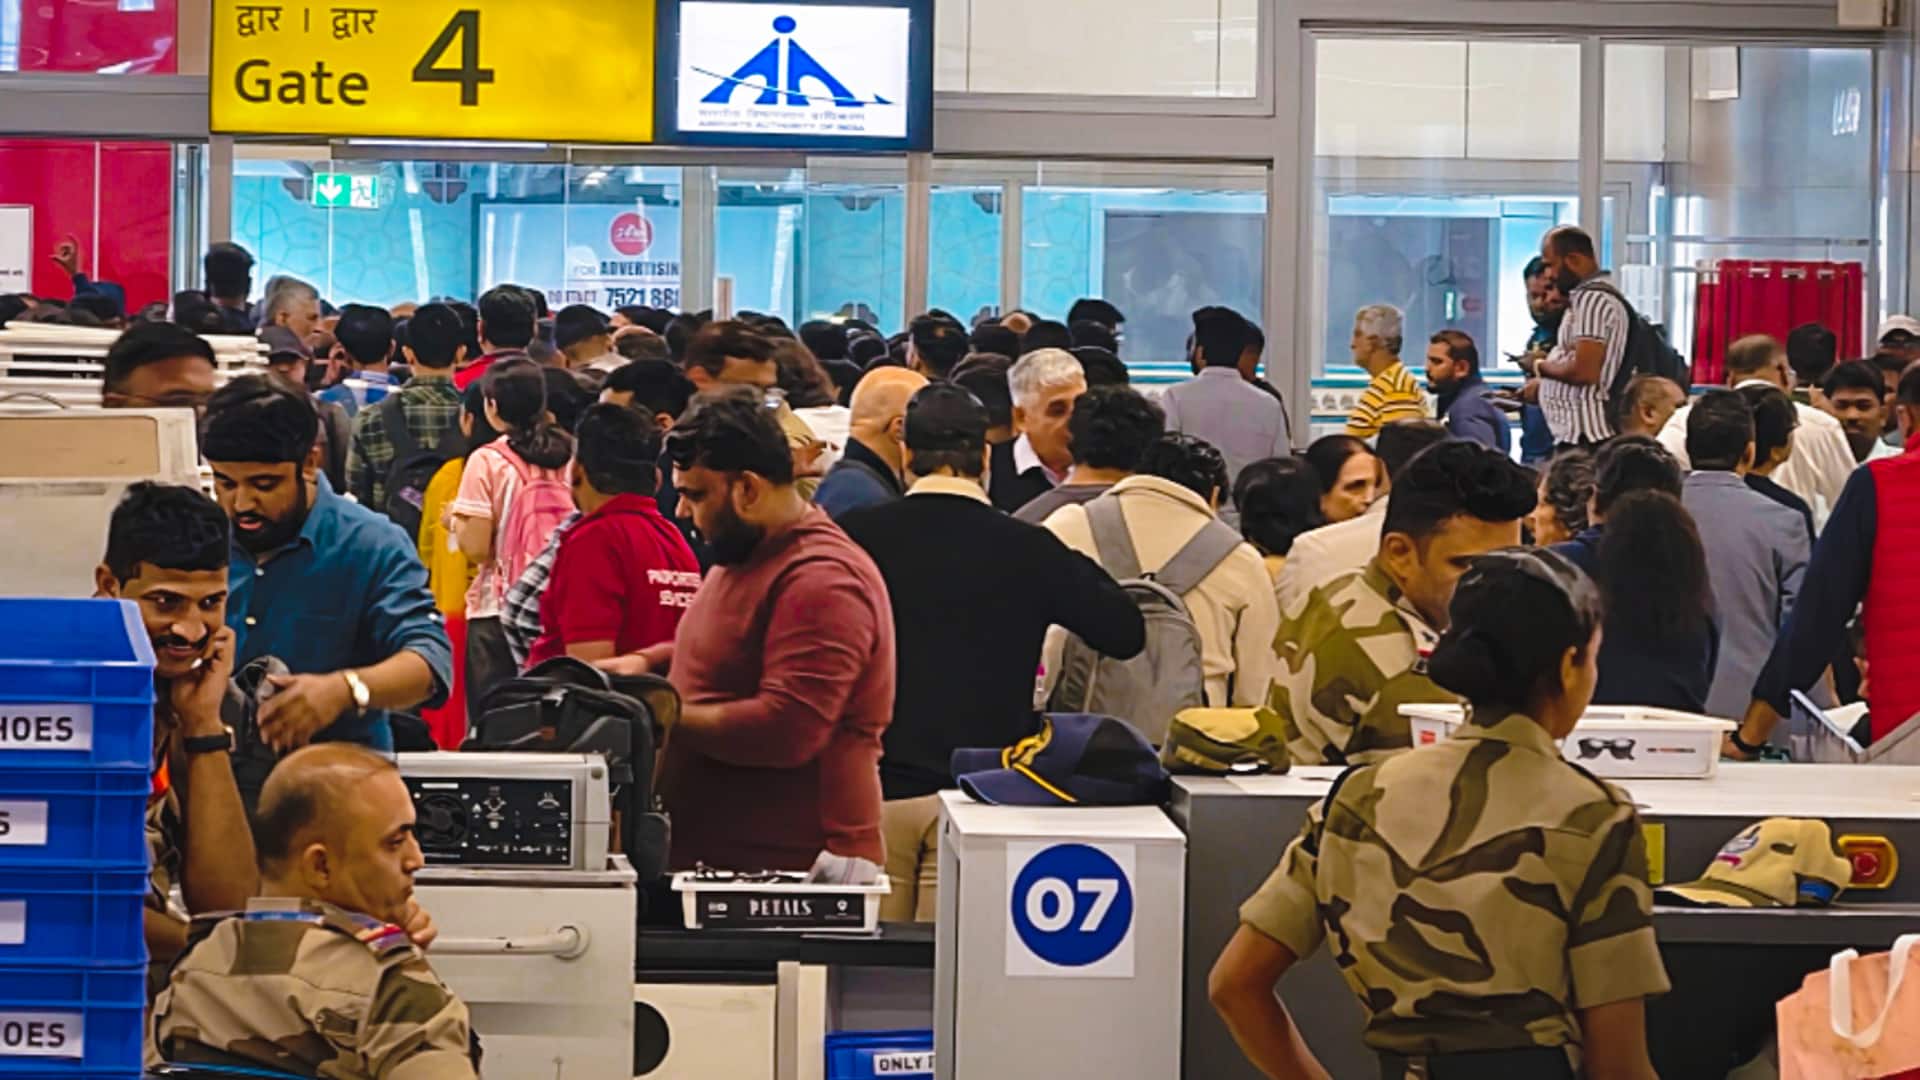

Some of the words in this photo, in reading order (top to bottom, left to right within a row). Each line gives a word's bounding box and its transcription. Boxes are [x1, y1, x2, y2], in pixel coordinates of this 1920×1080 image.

[235, 6, 283, 37] द्वार
[330, 8, 378, 39] द्वार
[234, 59, 369, 106] Gate
[412, 9, 495, 107] 4
[604, 287, 645, 308] 7521
[750, 899, 812, 916] PETALS
[1025, 877, 1120, 932] 07
[879, 1056, 922, 1071] ONLY
